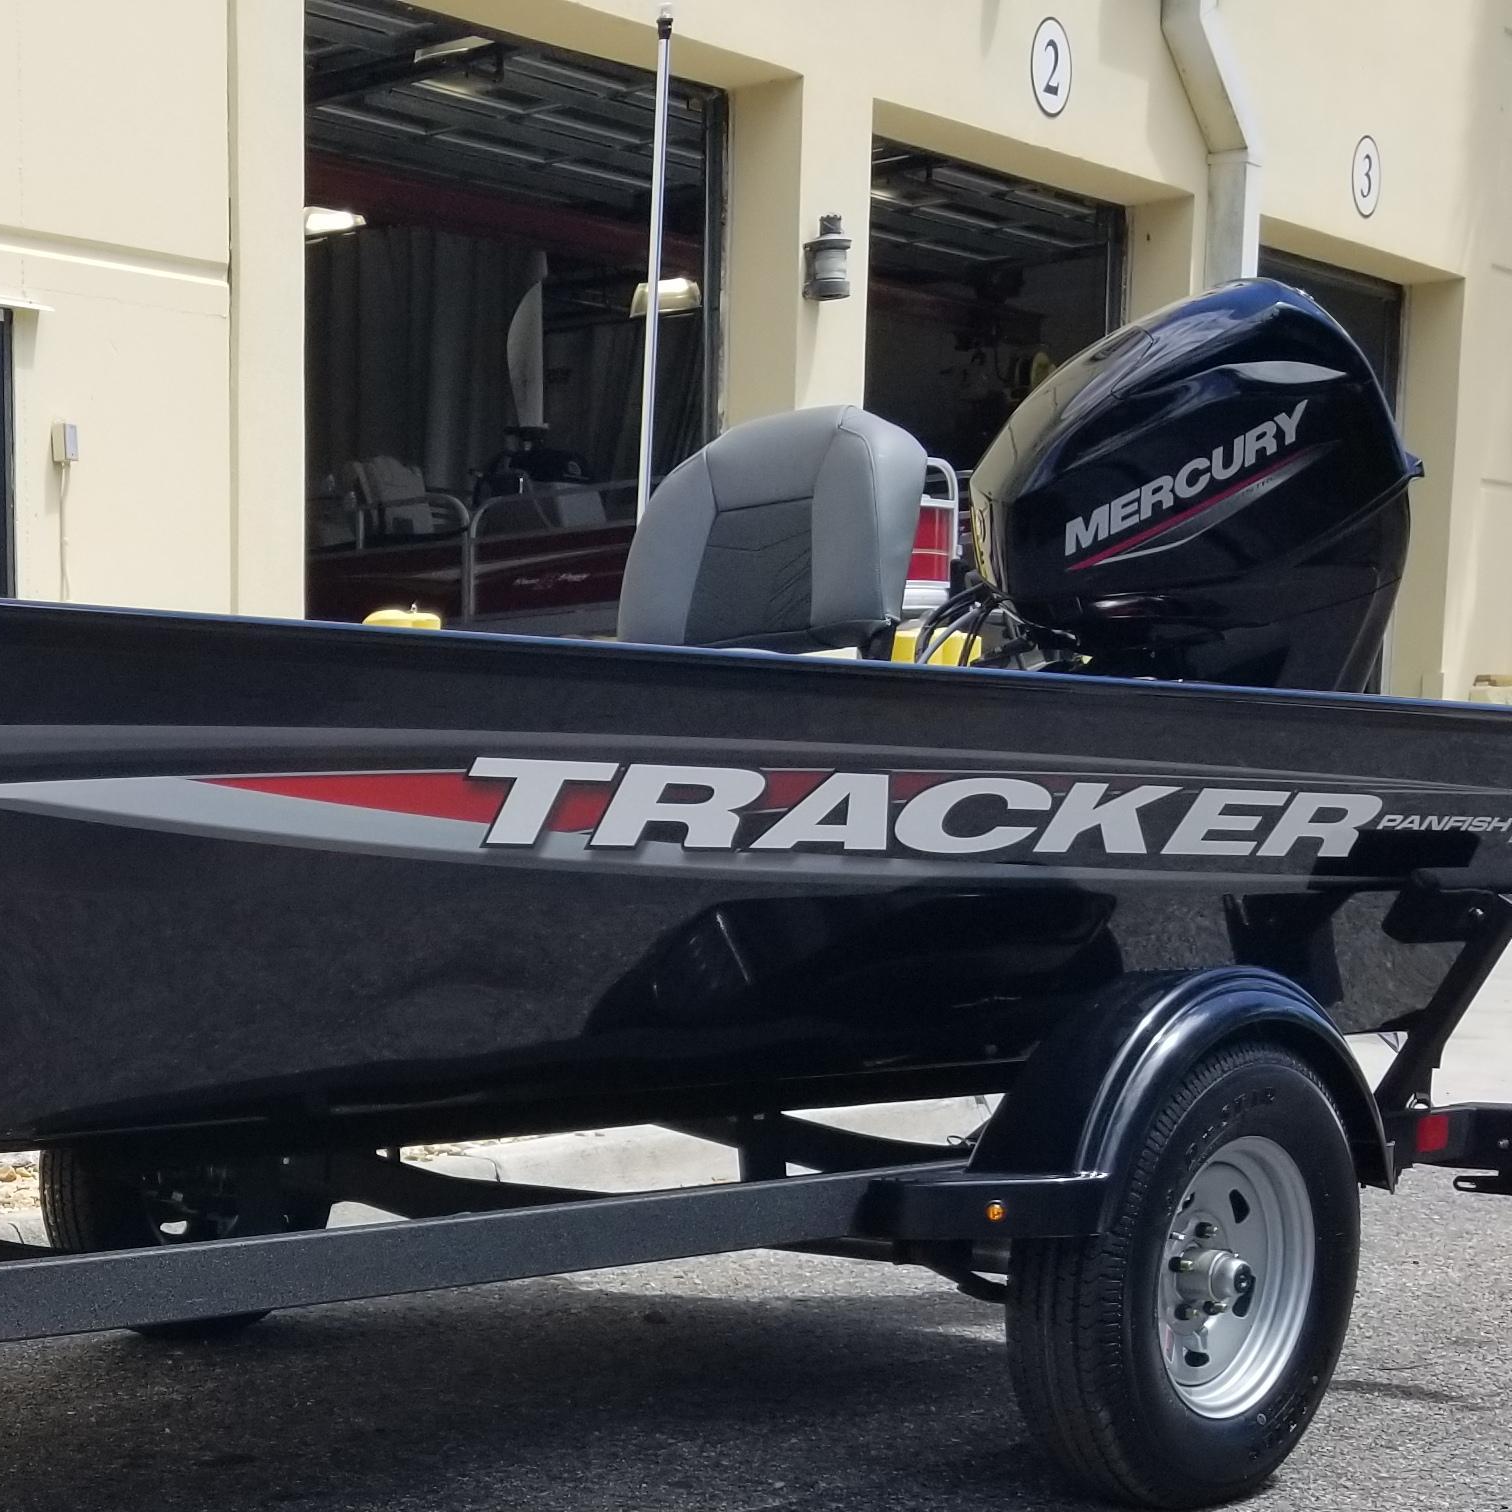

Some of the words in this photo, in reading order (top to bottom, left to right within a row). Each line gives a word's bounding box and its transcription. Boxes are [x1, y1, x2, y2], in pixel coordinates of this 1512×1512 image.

[1043, 38, 1060, 97] 2
[1360, 153, 1373, 199] 3
[1064, 399, 1309, 557] MERCURY
[467, 756, 1383, 858] TRACKER
[1375, 814, 1512, 832] PANFISH
